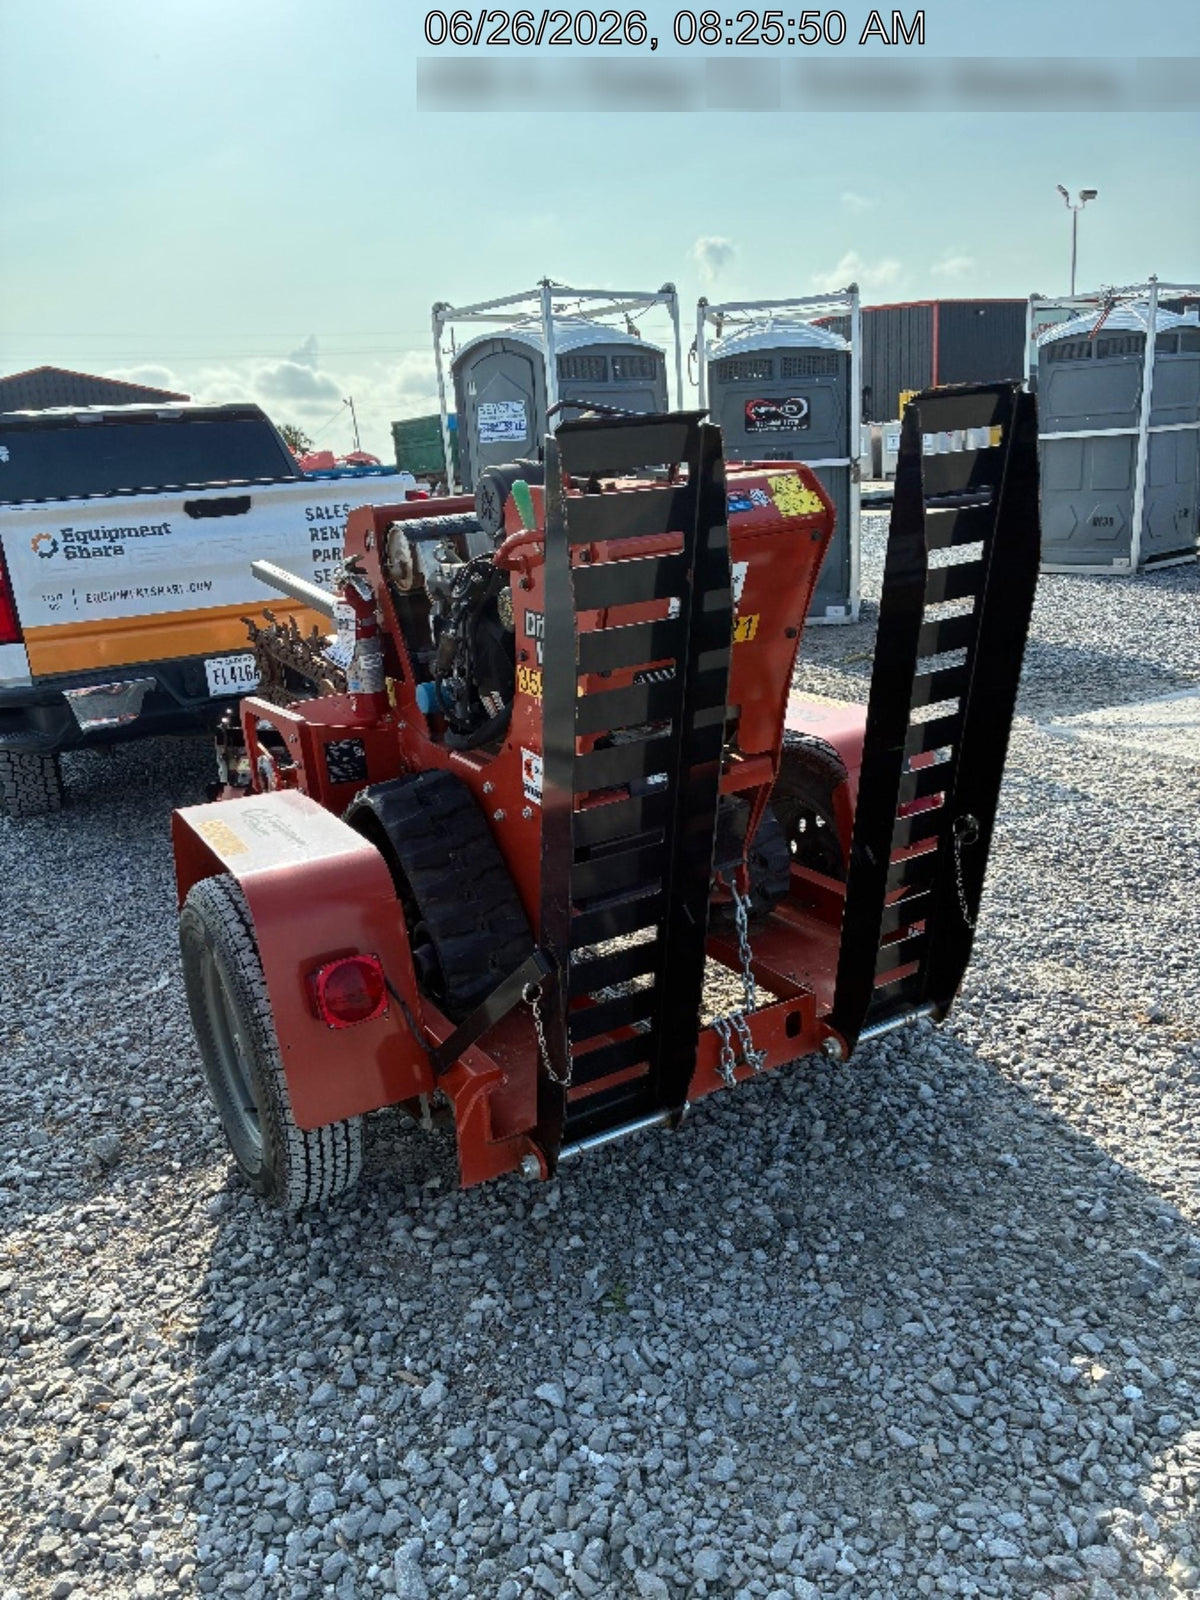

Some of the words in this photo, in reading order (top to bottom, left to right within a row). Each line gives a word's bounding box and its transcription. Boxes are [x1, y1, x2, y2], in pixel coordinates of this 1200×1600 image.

[304, 503, 350, 521] SALES
[60, 522, 171, 544] Equipment
[62, 544, 125, 560] Share
[312, 547, 345, 562] PAR
[518, 665, 543, 696] 35
